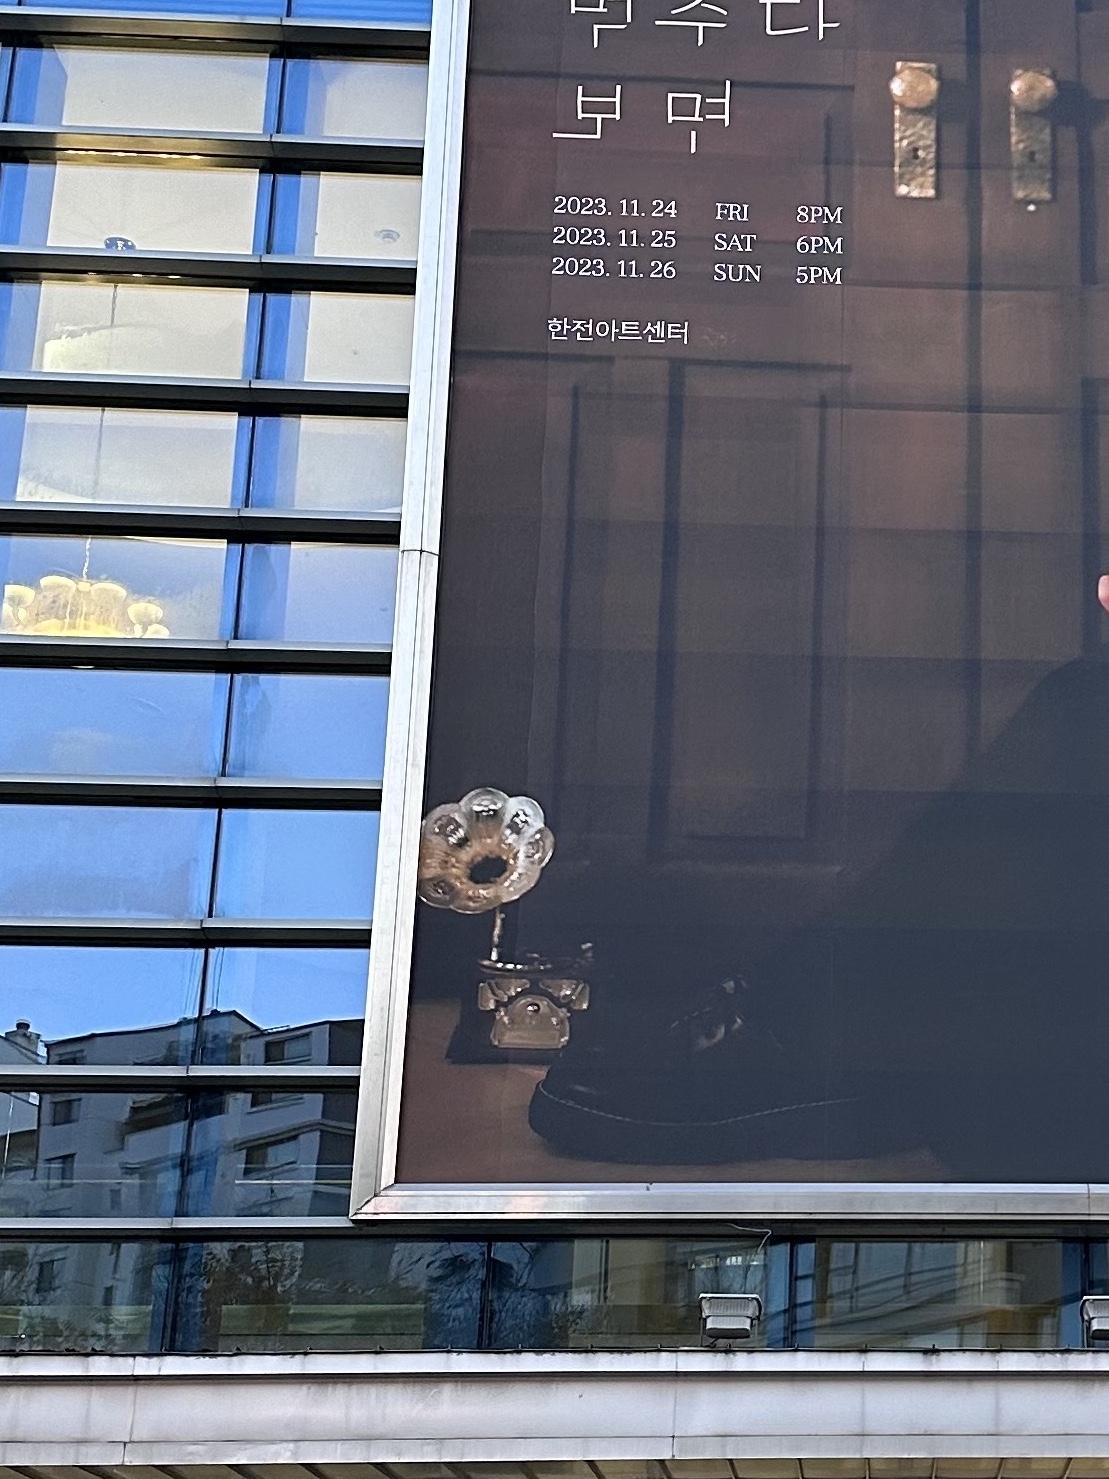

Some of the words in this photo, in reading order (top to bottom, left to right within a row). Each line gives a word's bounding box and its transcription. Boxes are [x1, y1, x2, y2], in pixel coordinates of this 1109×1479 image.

[554, 196, 611, 215] 2023.
[620, 199, 645, 216] 11.
[652, 200, 677, 217] 24
[716, 203, 749, 221] FRI
[797, 206, 842, 223] 8PM
[553, 227, 610, 246] 2023.
[619, 230, 644, 246] 11.
[651, 230, 675, 247] 25
[715, 234, 756, 251] SAT
[797, 236, 843, 254] 6PM
[552, 257, 609, 276] 2023.
[618, 260, 643, 277] 11.
[650, 261, 675, 278] 26
[714, 264, 761, 282] SUN
[796, 267, 842, 284] 5PM
[548, 318, 688, 344] 한전아트센터
